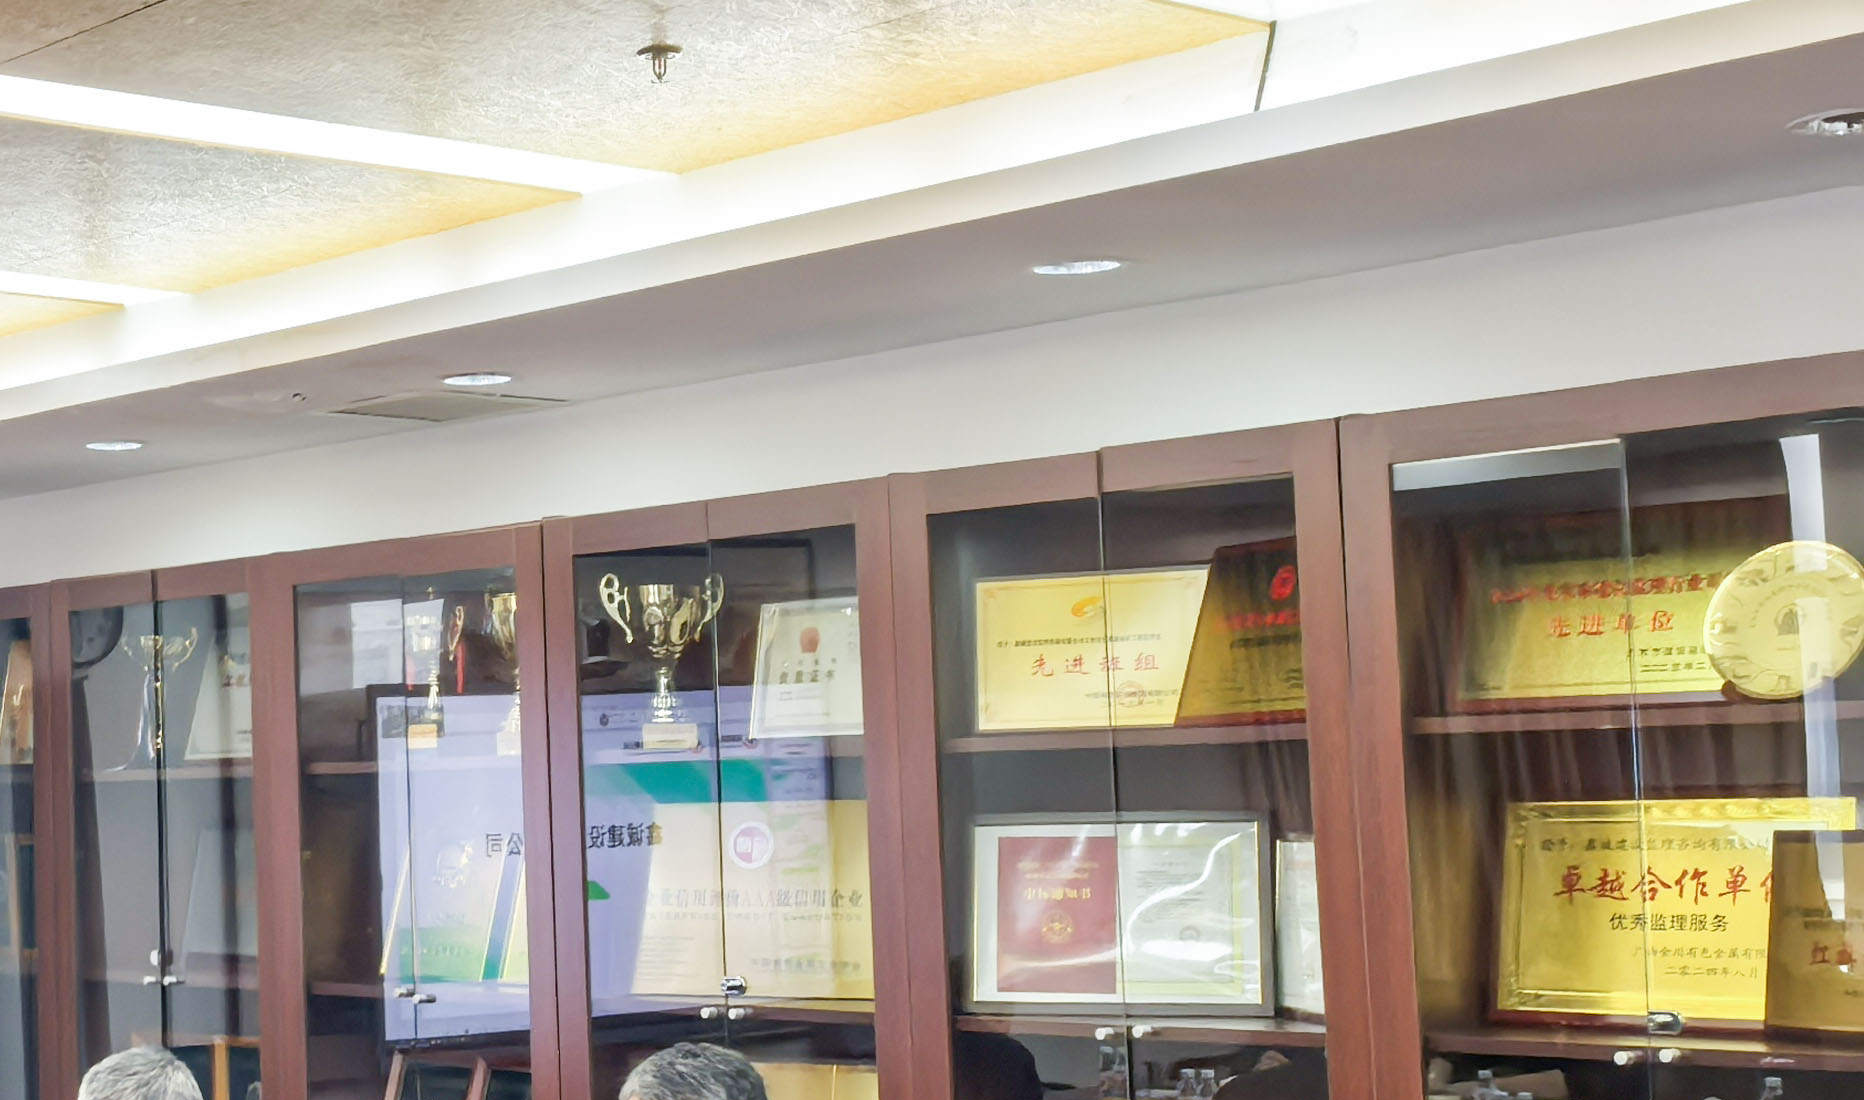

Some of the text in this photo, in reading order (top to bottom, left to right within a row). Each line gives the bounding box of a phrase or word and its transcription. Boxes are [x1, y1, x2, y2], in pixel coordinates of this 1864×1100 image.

[1608, 912, 1730, 933] 优秀监理服务
